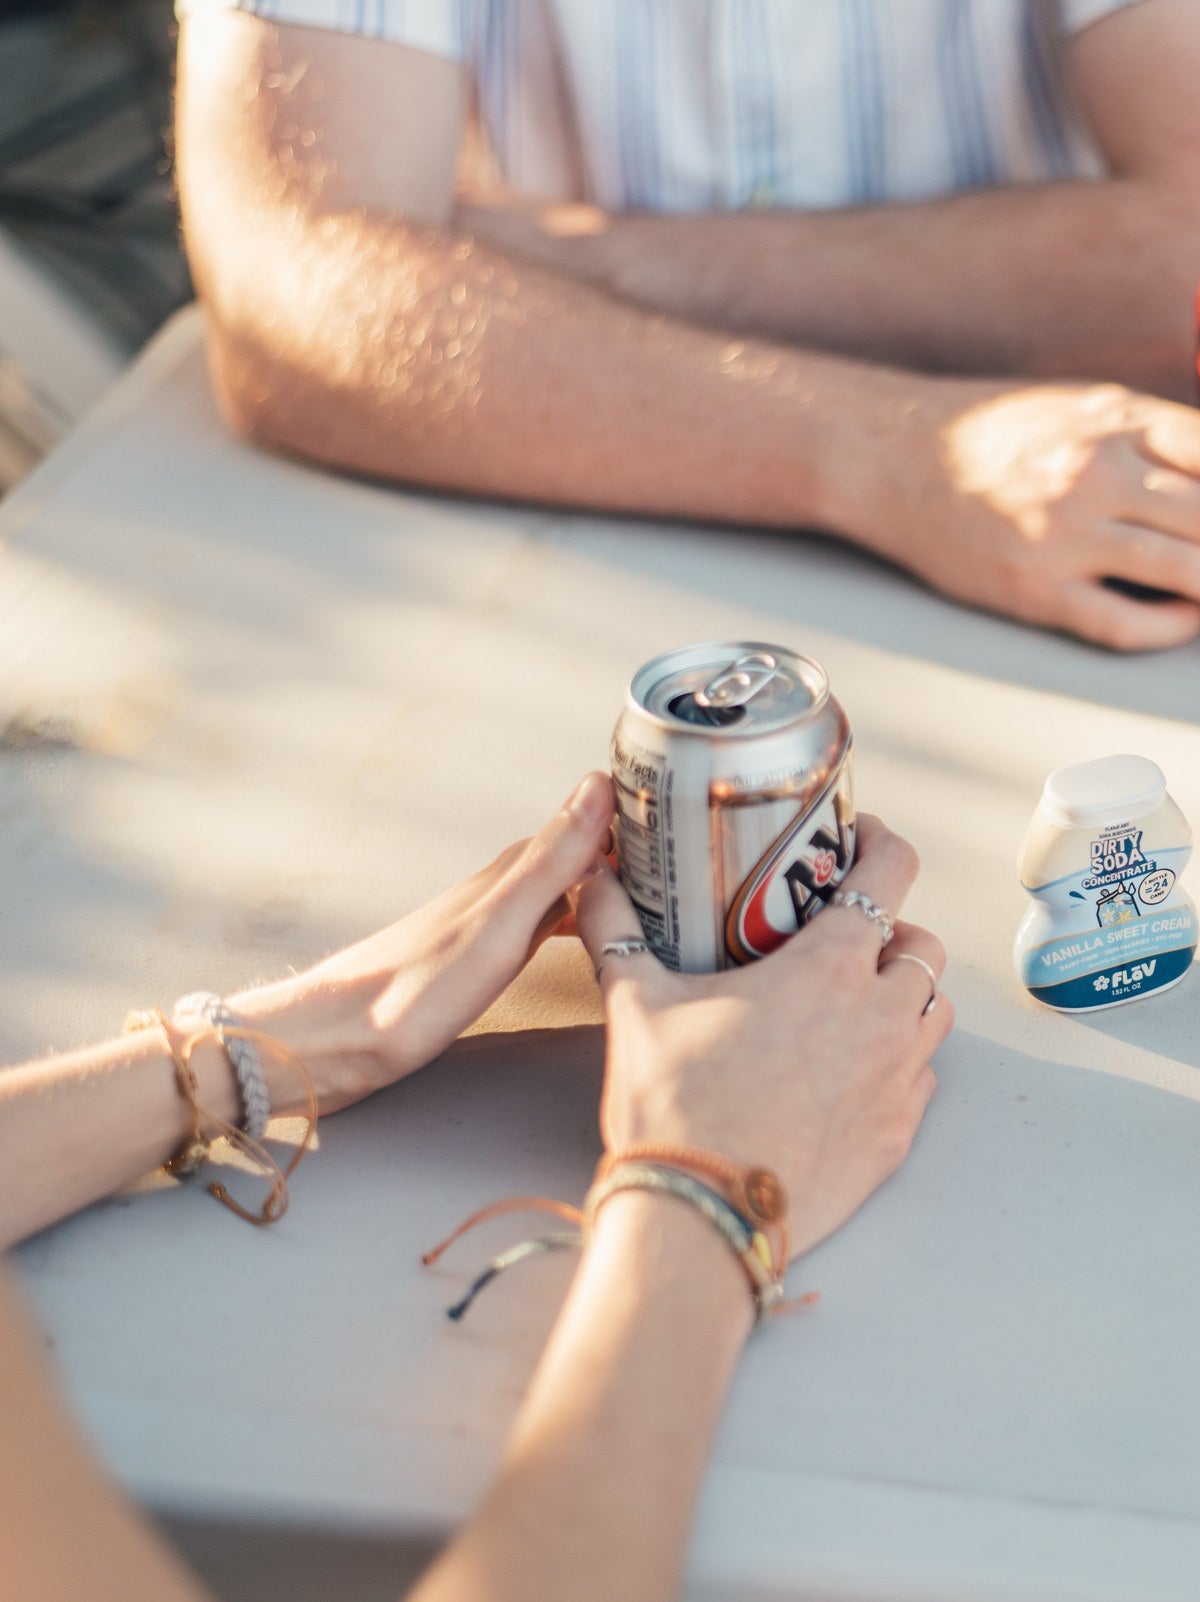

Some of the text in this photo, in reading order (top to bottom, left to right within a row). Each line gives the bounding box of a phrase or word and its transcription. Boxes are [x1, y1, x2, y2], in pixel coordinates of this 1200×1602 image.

[1091, 831, 1142, 858] DIRTY
[1082, 860, 1155, 889] CONCENTRATE
[1091, 848, 1143, 875] SODA
[1041, 937, 1104, 966] VANILLA
[1107, 922, 1149, 944] SWEET
[1151, 917, 1191, 933] CREAM
[1112, 988, 1123, 996] 1.52
[1123, 985, 1130, 993] FL
